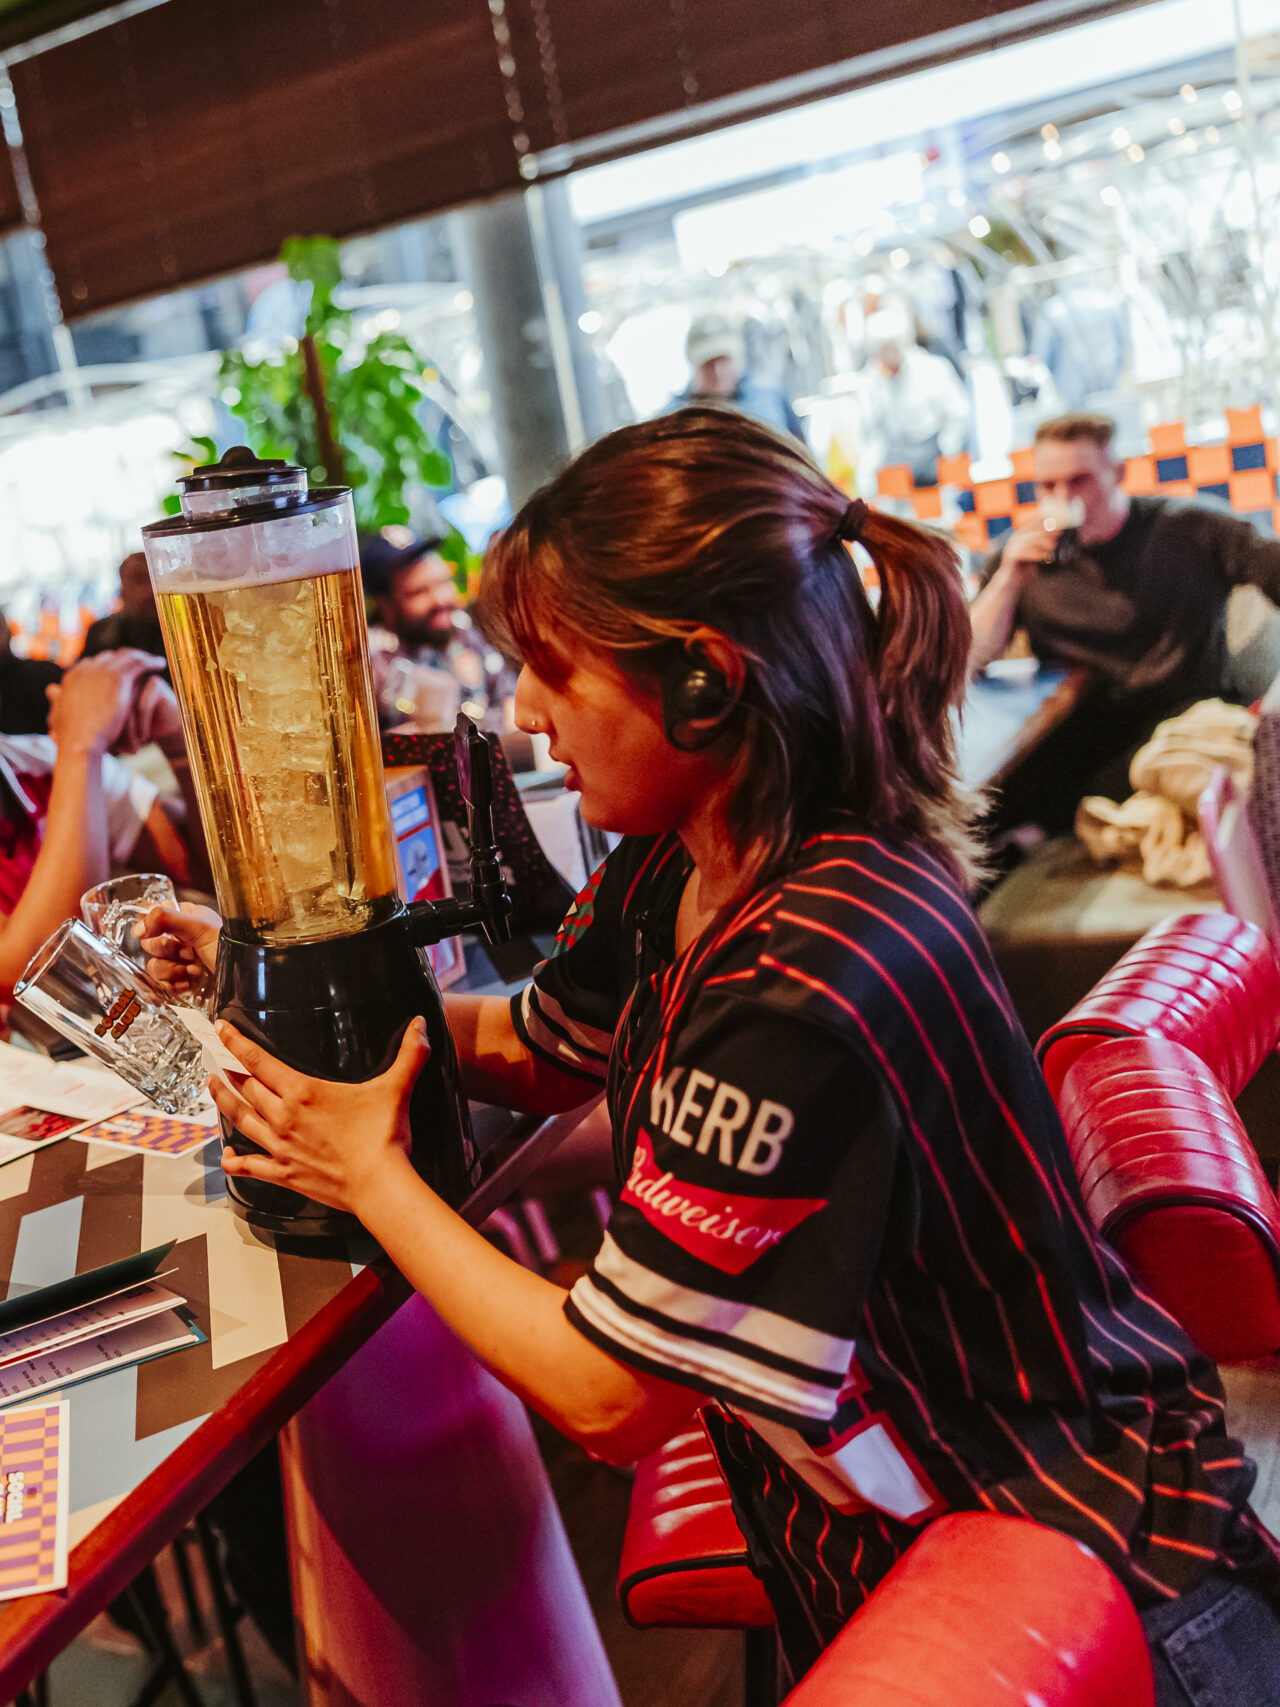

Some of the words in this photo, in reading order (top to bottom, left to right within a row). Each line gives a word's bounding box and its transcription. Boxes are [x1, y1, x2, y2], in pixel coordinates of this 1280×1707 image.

[94, 988, 136, 1038] SOCIAL
[111, 1001, 141, 1040] CLUB
[650, 1066, 795, 1176] KERB
[4, 1471, 24, 1523] SOCIAL
